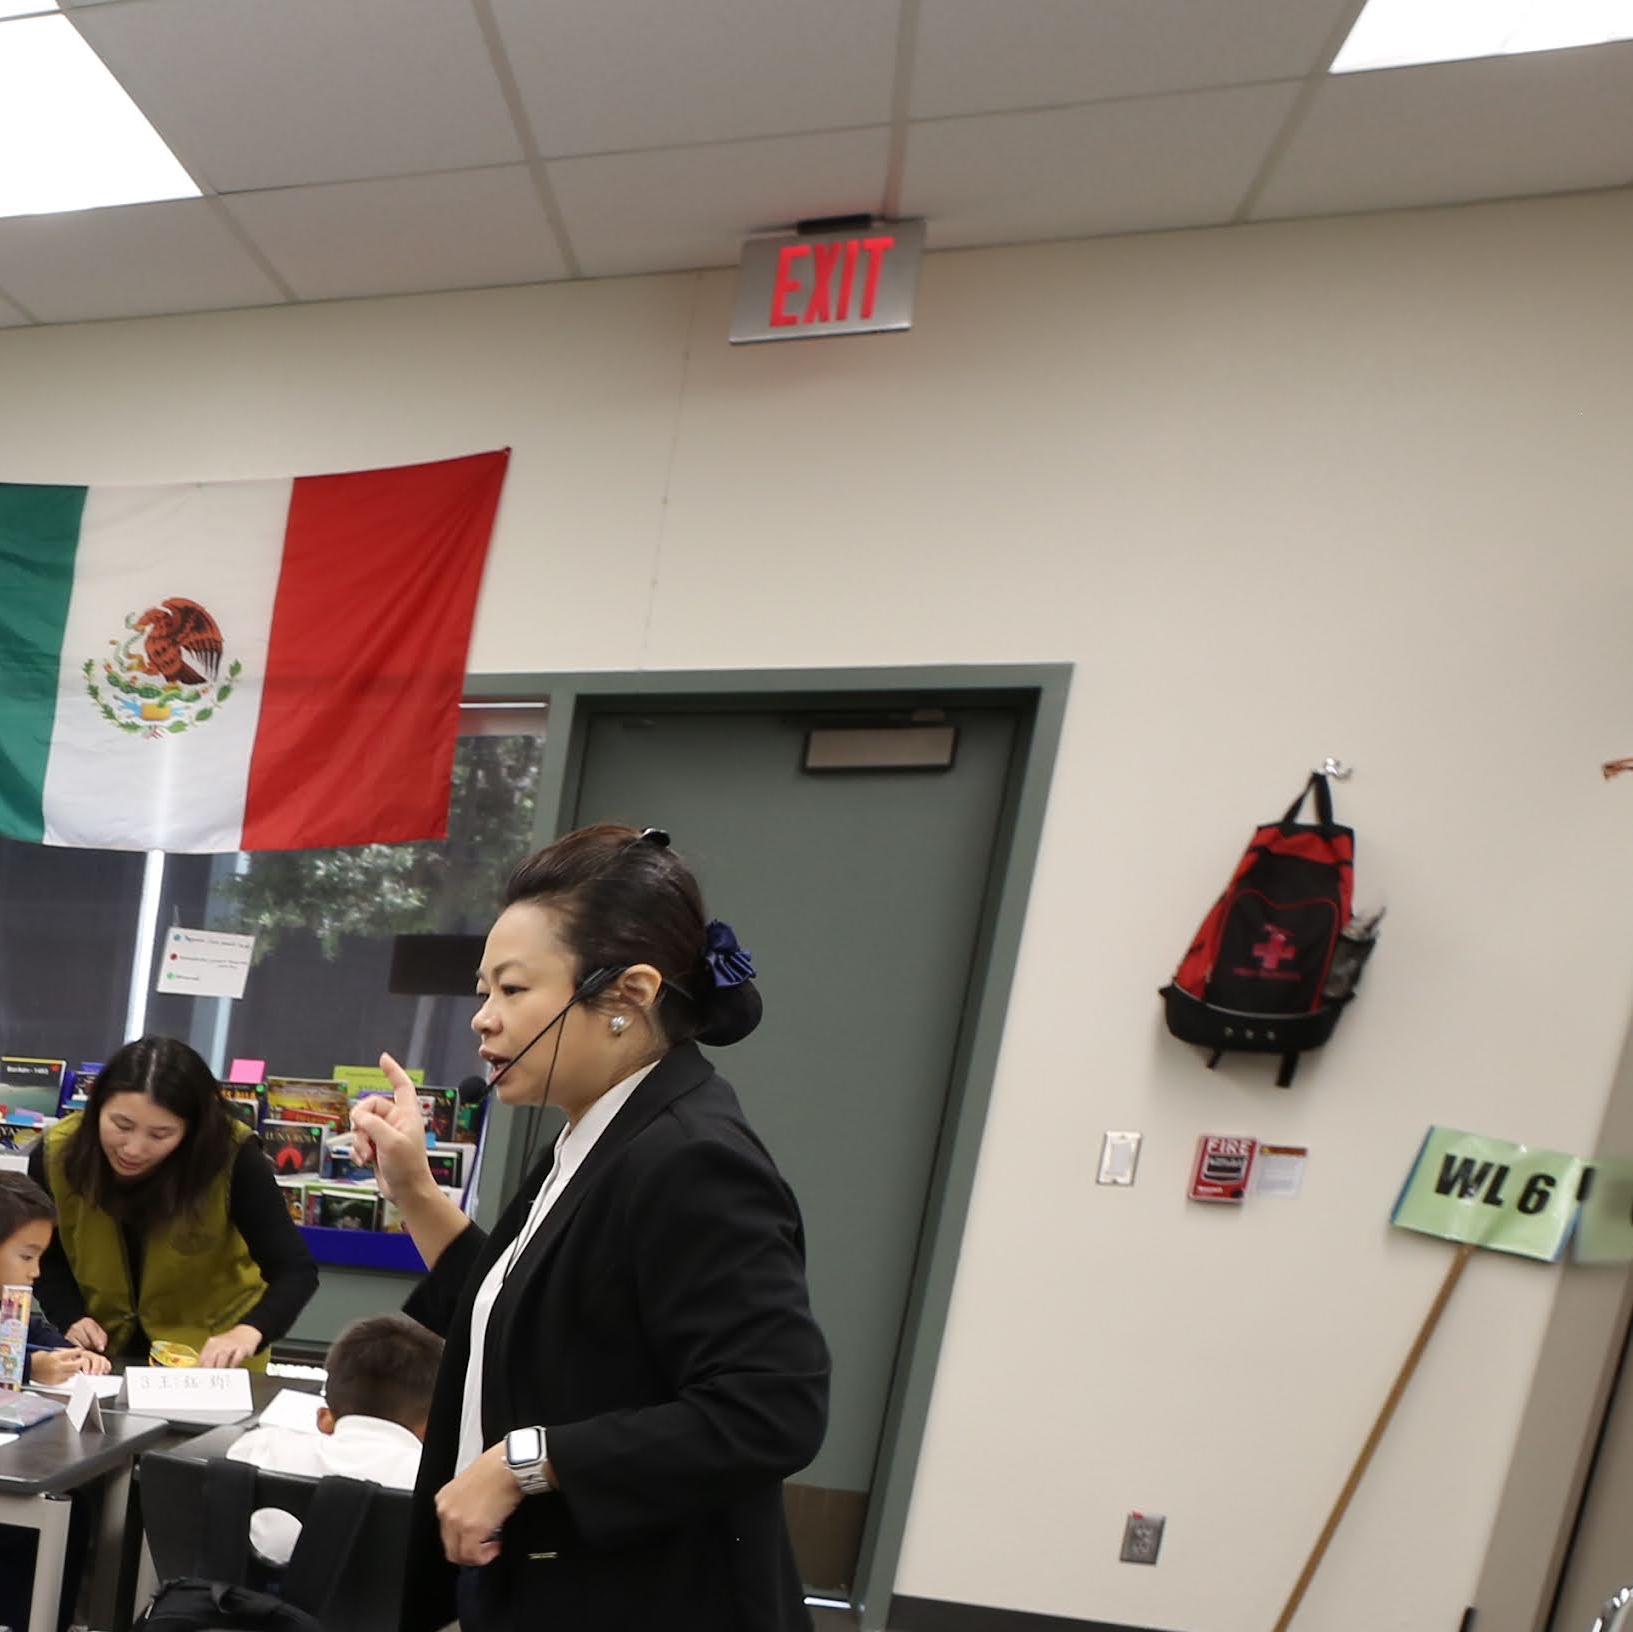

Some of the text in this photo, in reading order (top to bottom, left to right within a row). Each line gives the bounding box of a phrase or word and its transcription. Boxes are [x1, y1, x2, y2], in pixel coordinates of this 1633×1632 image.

[768, 235, 896, 328] EXIT
[1206, 1137, 1253, 1155] FIRE
[1434, 1152, 1511, 1208] WL
[1516, 1173, 1558, 1215] 6
